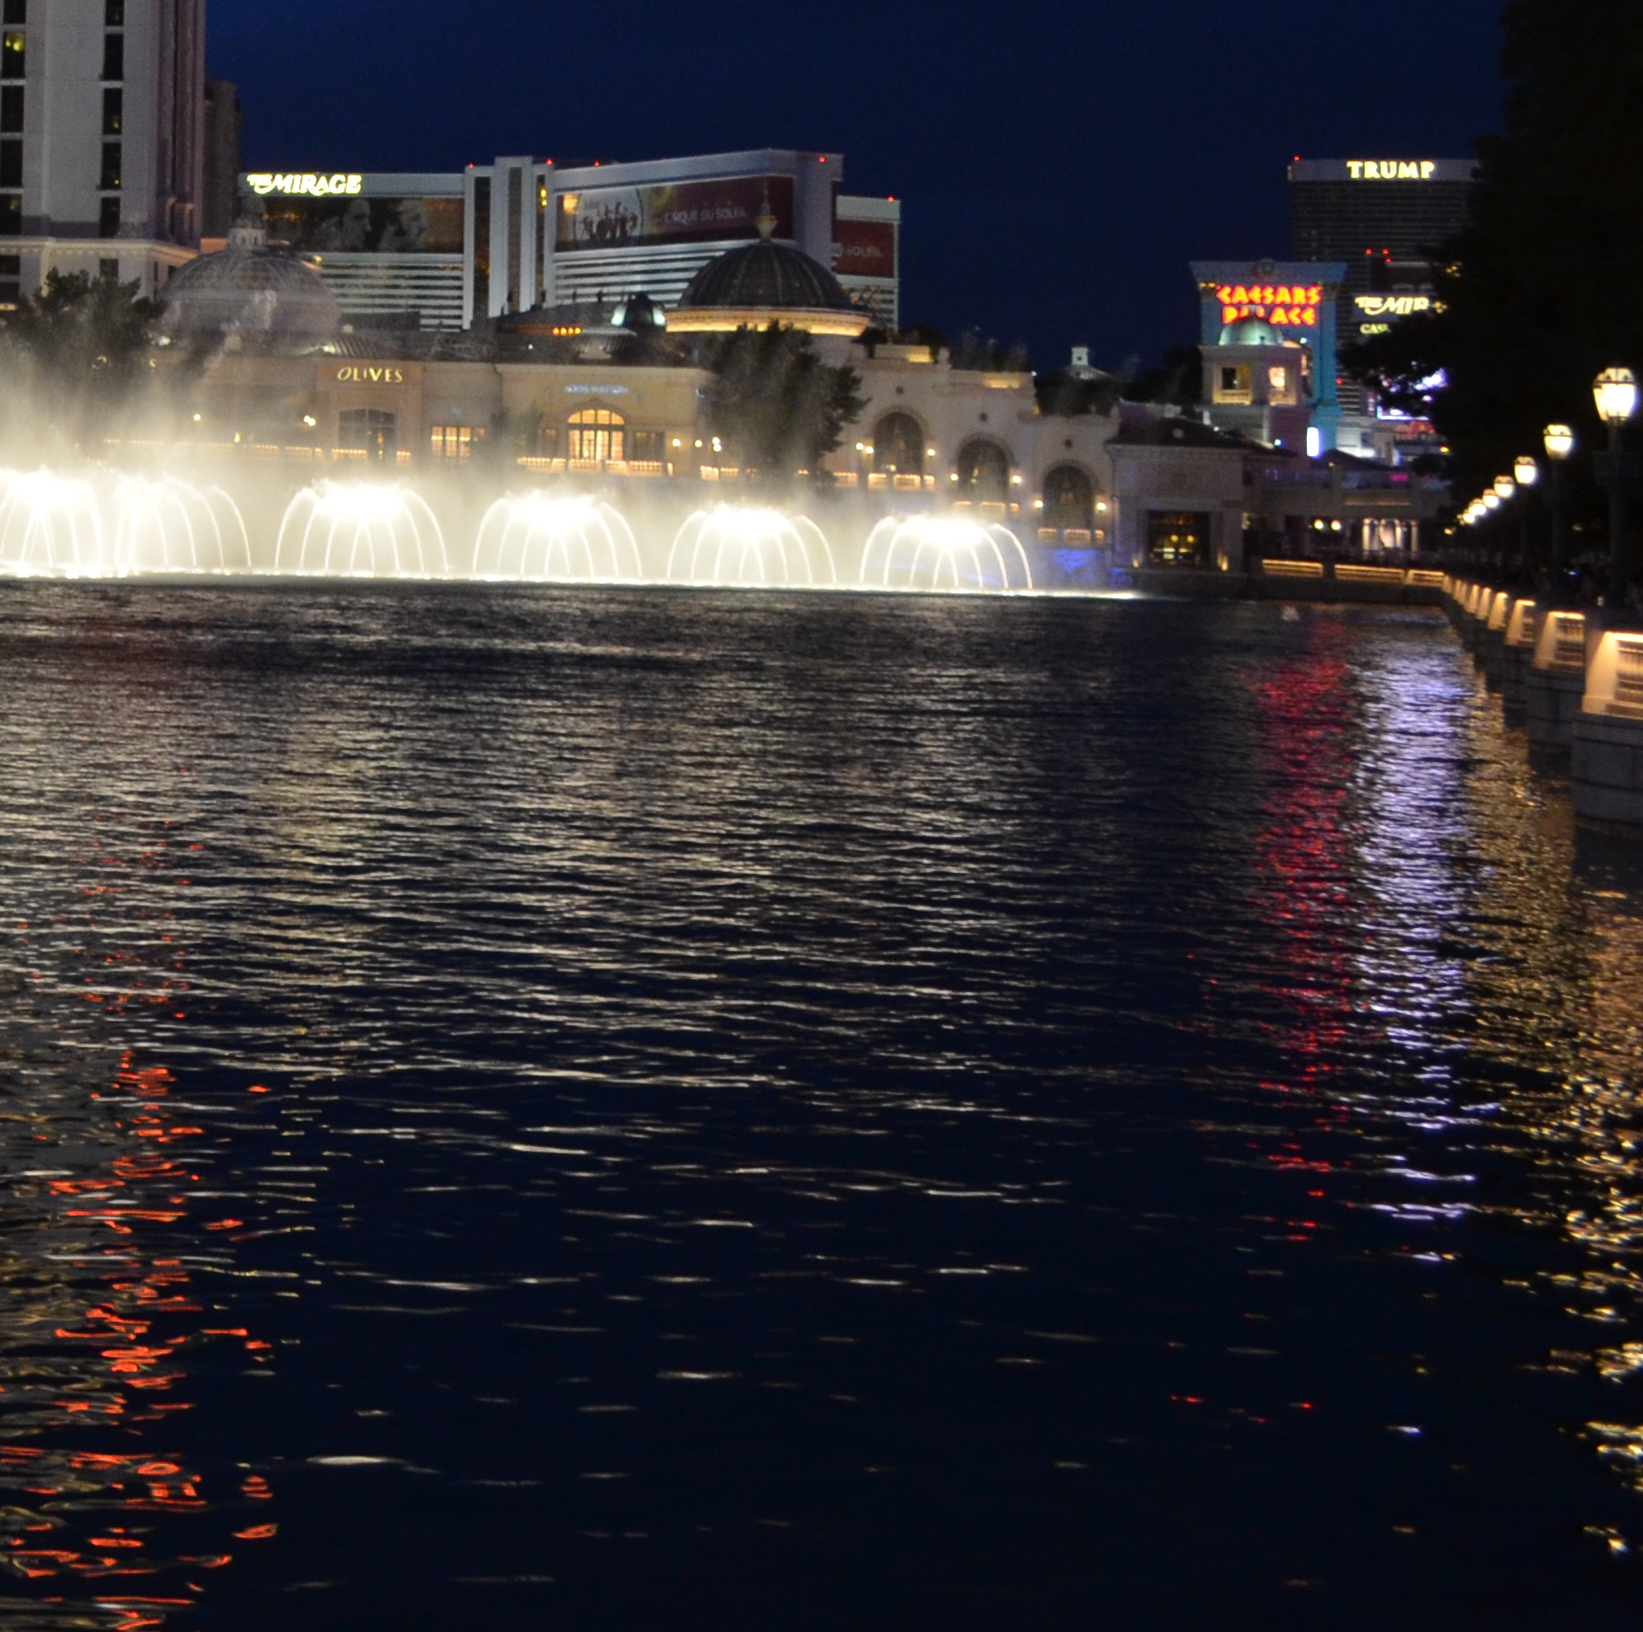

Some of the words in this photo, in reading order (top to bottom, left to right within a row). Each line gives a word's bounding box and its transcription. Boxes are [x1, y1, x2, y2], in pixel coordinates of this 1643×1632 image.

[1345, 159, 1435, 179] TRUMP
[254, 173, 362, 197] MIRAGE
[1216, 285, 1321, 305] CAESARS
[337, 366, 404, 383] OLIVES
